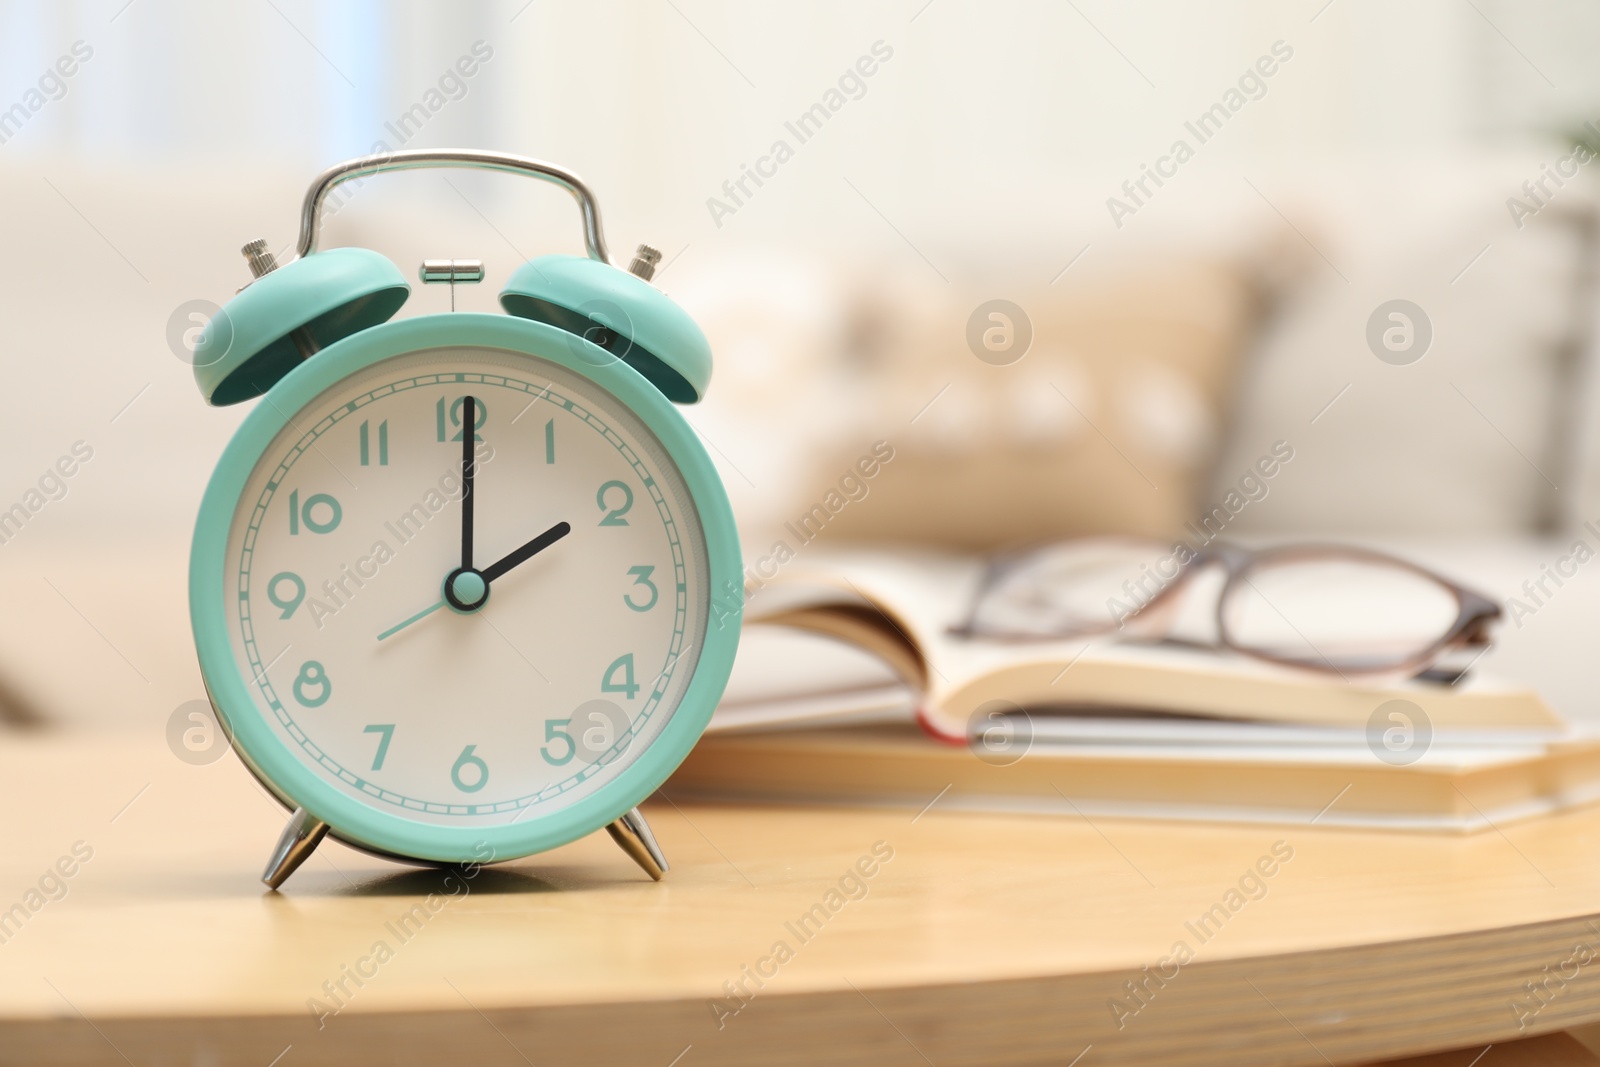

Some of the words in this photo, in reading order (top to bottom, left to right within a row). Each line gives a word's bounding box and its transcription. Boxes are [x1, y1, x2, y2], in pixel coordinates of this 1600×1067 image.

[436, 395, 487, 442] 12
[545, 418, 555, 464] 1
[360, 419, 388, 466] 11
[289, 488, 342, 535] 10
[596, 480, 634, 526] 2
[267, 572, 306, 619] 9
[623, 566, 658, 612] 3
[293, 660, 331, 708] 8
[601, 653, 640, 700] 4
[363, 724, 396, 771] 7
[540, 719, 576, 766] 5
[451, 745, 489, 793] 6
